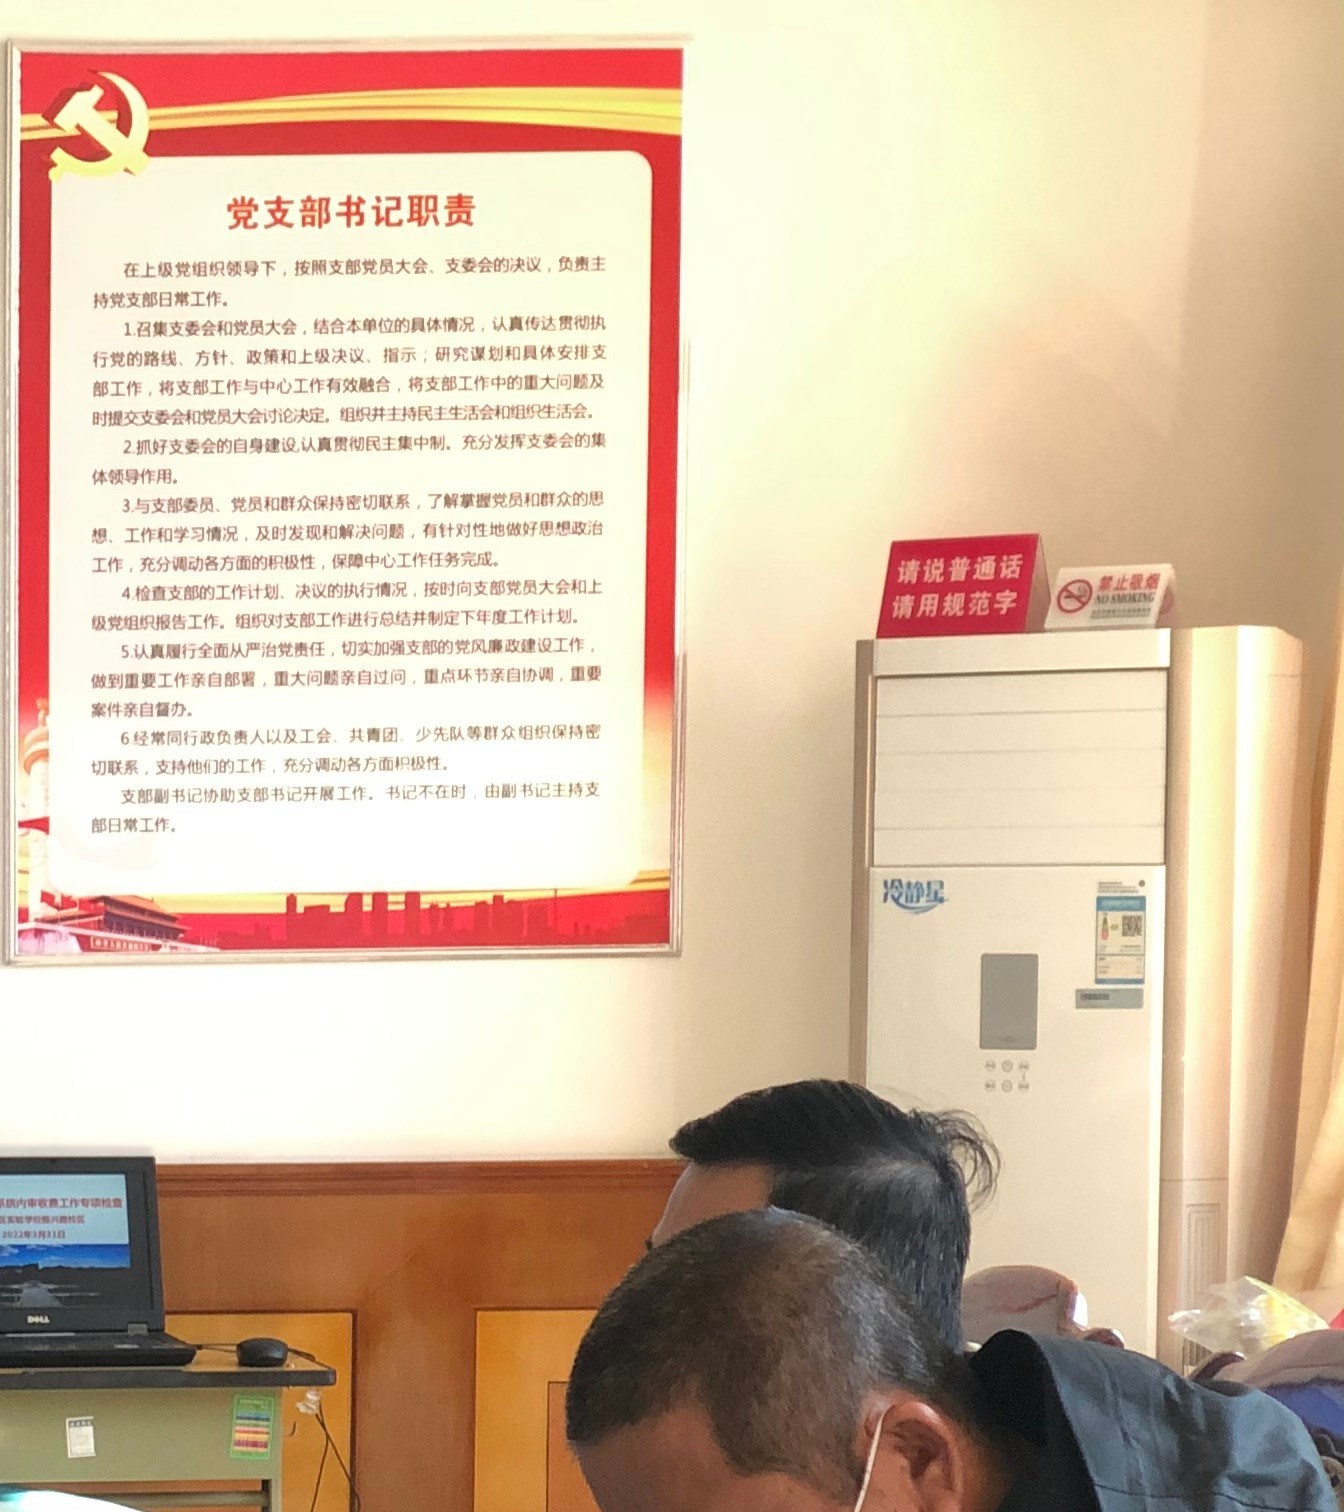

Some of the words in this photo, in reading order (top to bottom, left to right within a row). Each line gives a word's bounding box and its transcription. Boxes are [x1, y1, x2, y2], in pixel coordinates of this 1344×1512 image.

[227, 193, 476, 229] 党支部书记职责
[93, 290, 229, 311] 持党支部日常工作。
[92, 467, 178, 486] 体领导作用。
[896, 554, 1023, 583] 请说普通话
[892, 589, 1018, 619] 请用规范字
[92, 701, 193, 720] 案件亲自督办。
[91, 816, 177, 835] 部日常工作。
[27, 1315, 50, 1324] DELL
